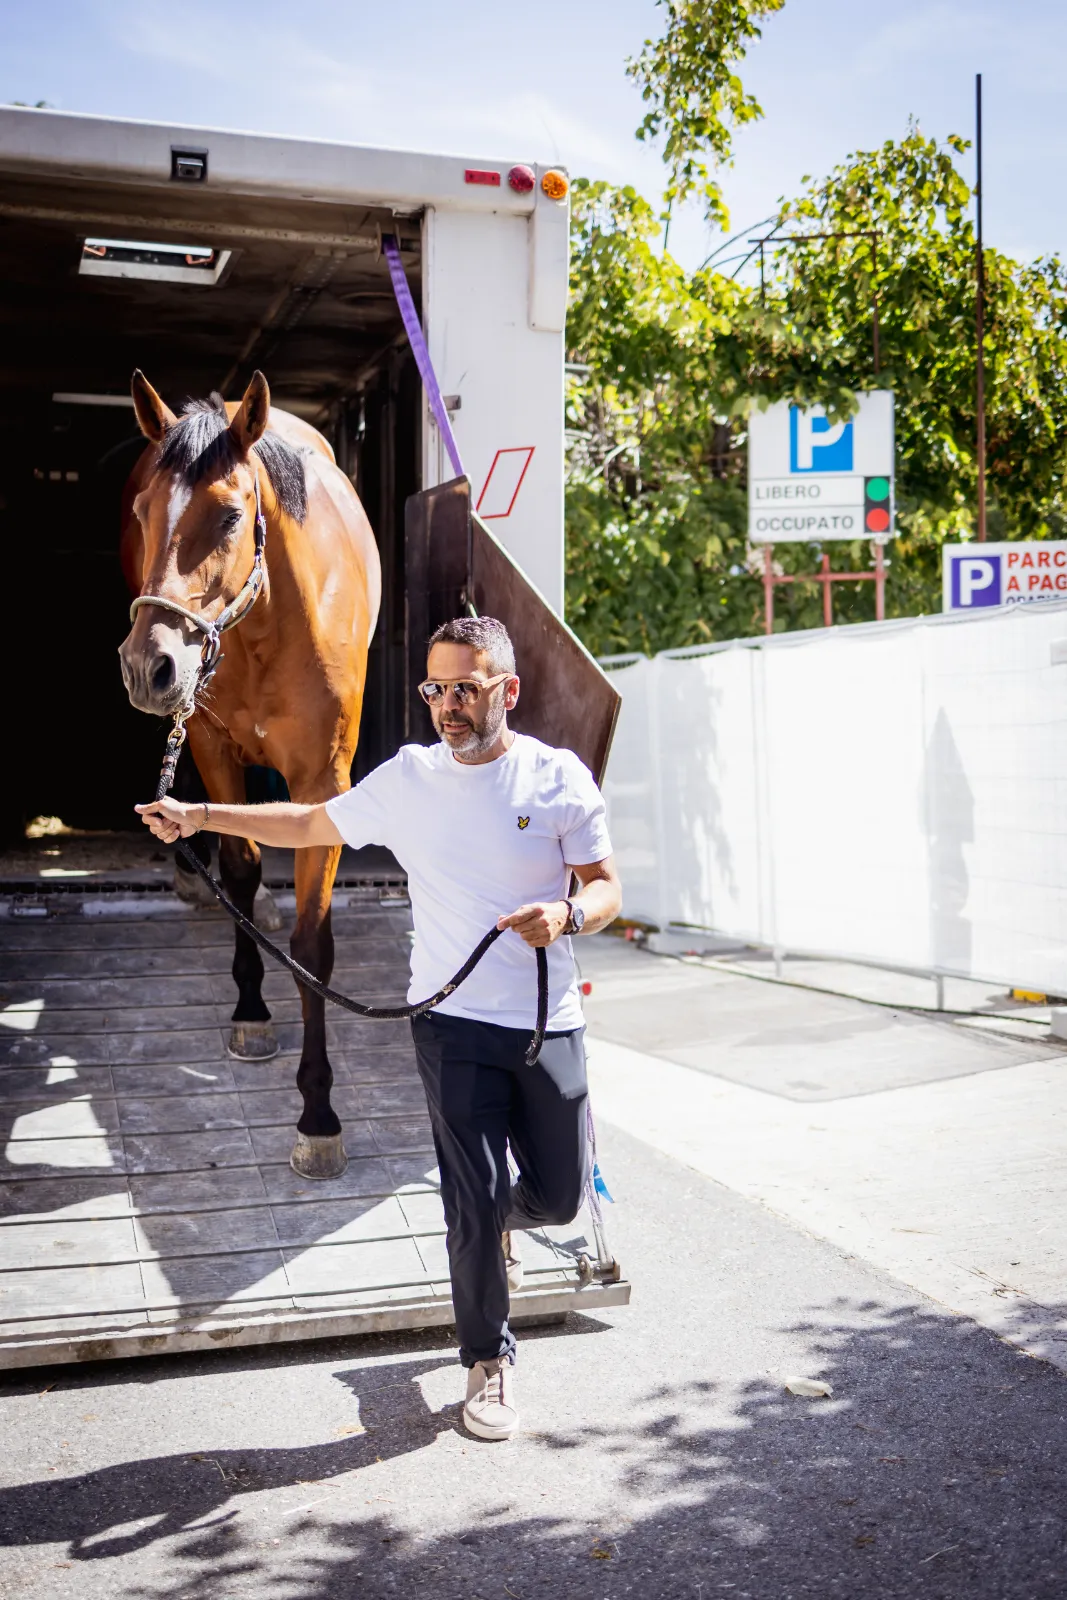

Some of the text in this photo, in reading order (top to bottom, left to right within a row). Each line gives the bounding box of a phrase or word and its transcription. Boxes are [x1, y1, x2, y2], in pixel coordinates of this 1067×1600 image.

[797, 401, 847, 469] P
[755, 484, 821, 500] LIBERO
[756, 515, 854, 531] OCCUPATO
[1007, 551, 1067, 568] PARC
[959, 559, 994, 606] P
[1007, 573, 1067, 591] A PAG
